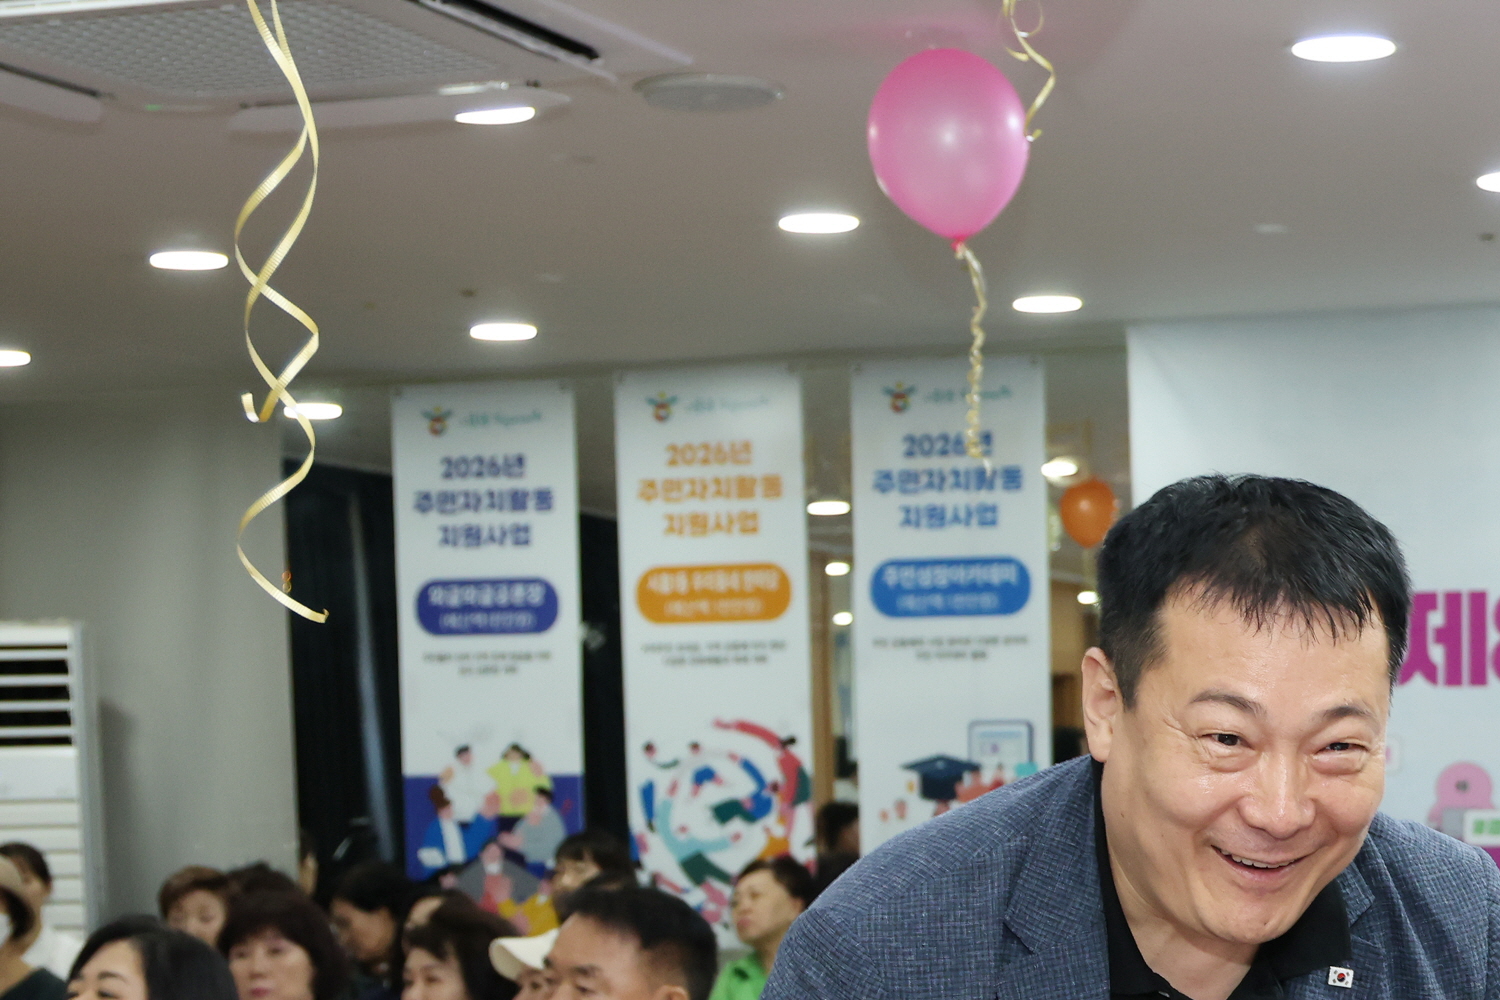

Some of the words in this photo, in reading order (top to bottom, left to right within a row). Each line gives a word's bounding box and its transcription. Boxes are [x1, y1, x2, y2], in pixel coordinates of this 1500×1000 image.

[440, 453, 527, 480] 2026년
[665, 441, 753, 467] 2026년
[637, 474, 783, 503] 주민자치활동
[872, 466, 1023, 495] 주민자치활동
[414, 487, 553, 515] 주민자치활동
[664, 511, 760, 538] 지원사업
[899, 503, 998, 529] 지원사업
[439, 523, 531, 548] 지원사업
